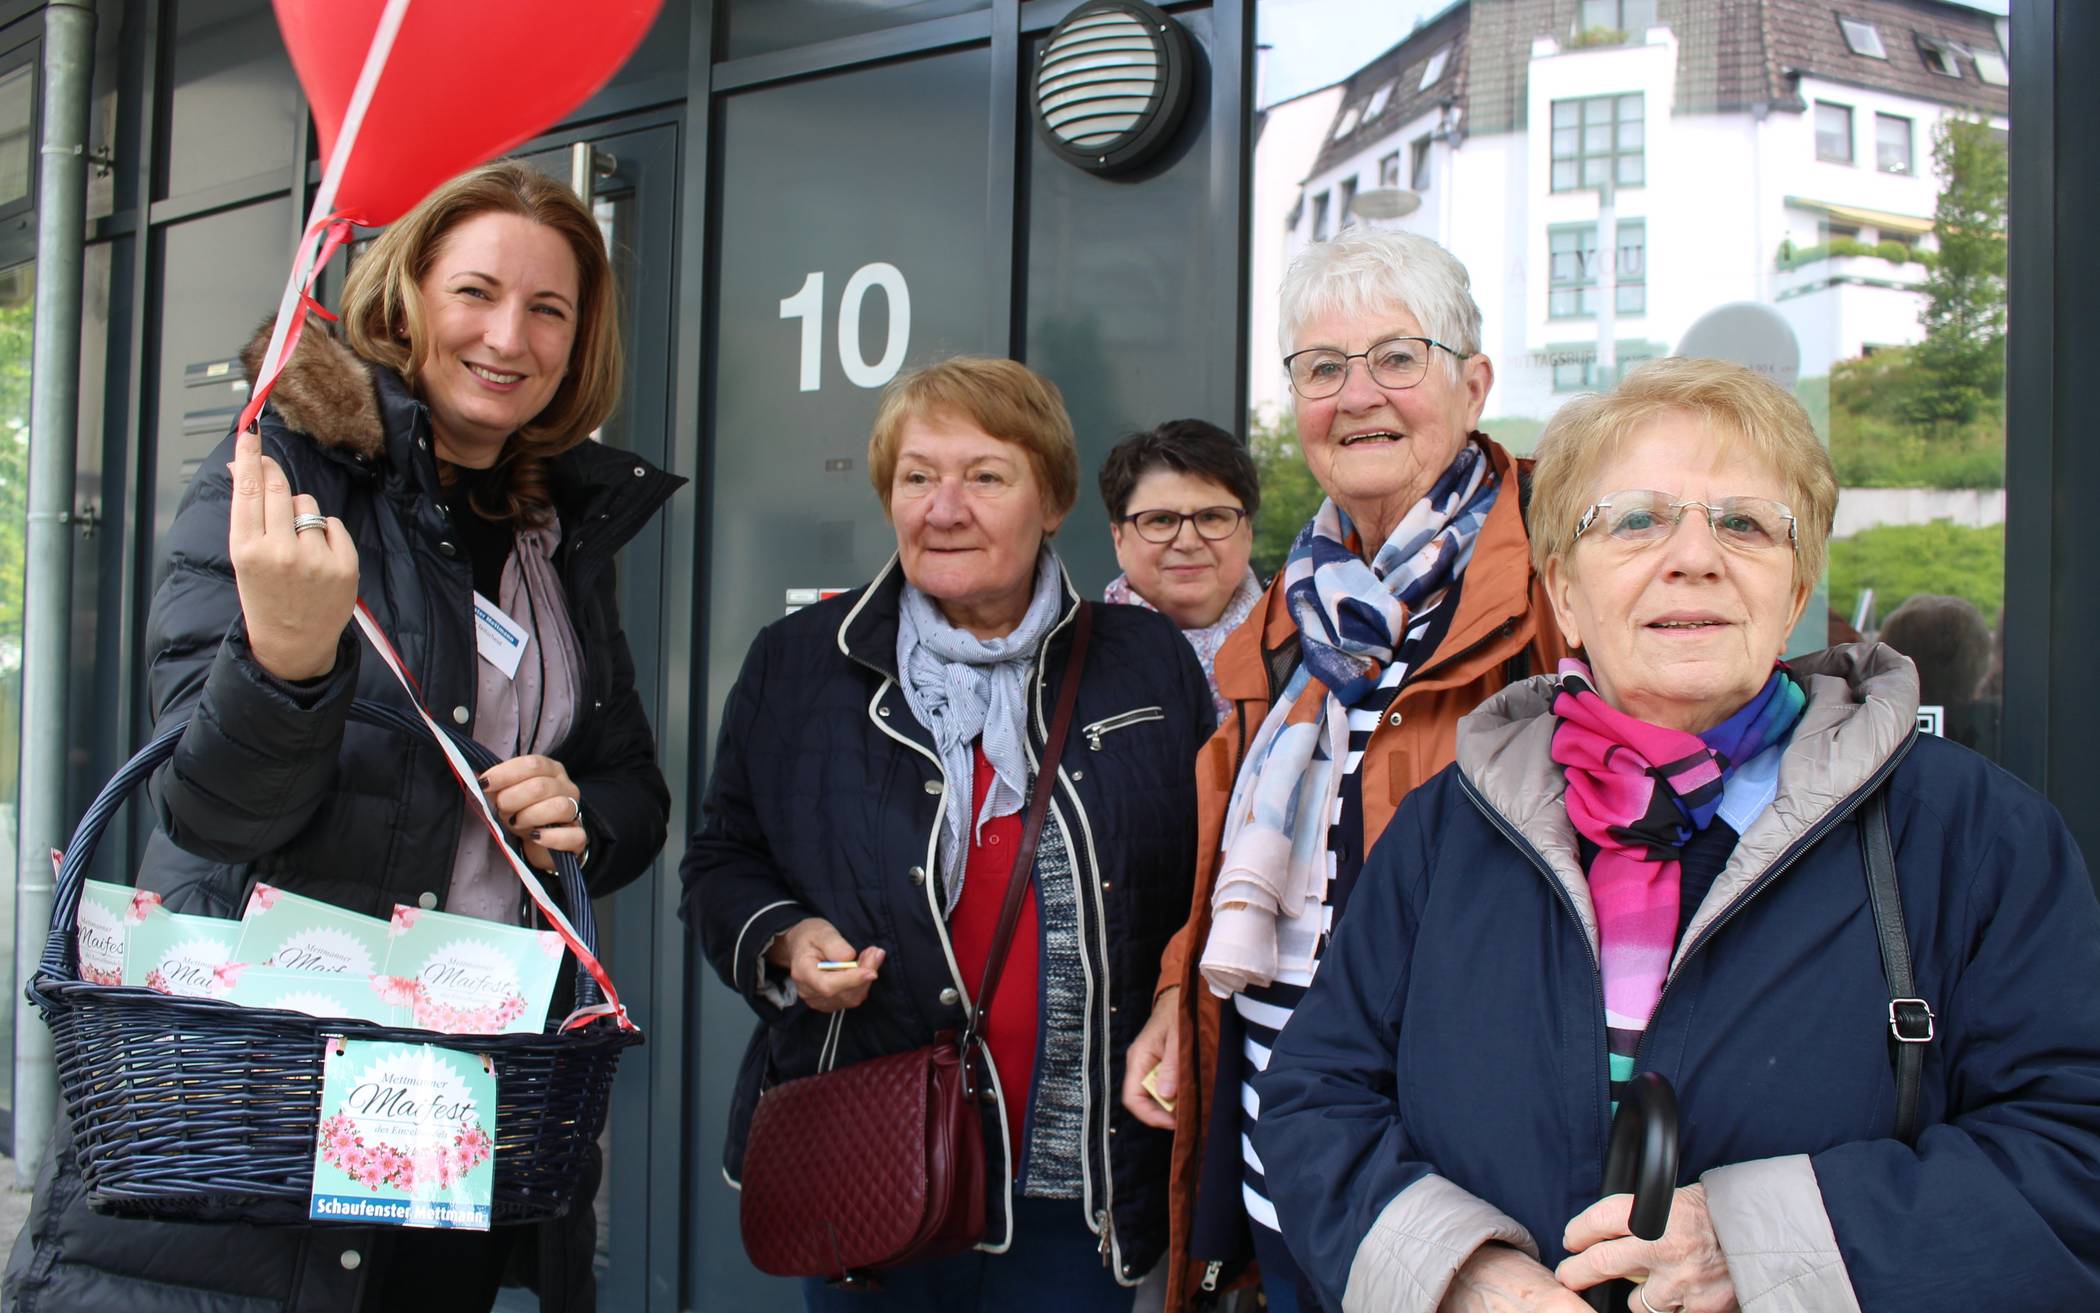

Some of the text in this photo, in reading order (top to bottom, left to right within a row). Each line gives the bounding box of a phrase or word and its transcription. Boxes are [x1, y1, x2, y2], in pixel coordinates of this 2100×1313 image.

[779, 262, 911, 392] 10
[79, 926, 124, 956] Maifes
[424, 963, 512, 993] Maifest
[348, 1083, 477, 1125] Maifest
[317, 1197, 483, 1223] Schaufenster Mettmann
